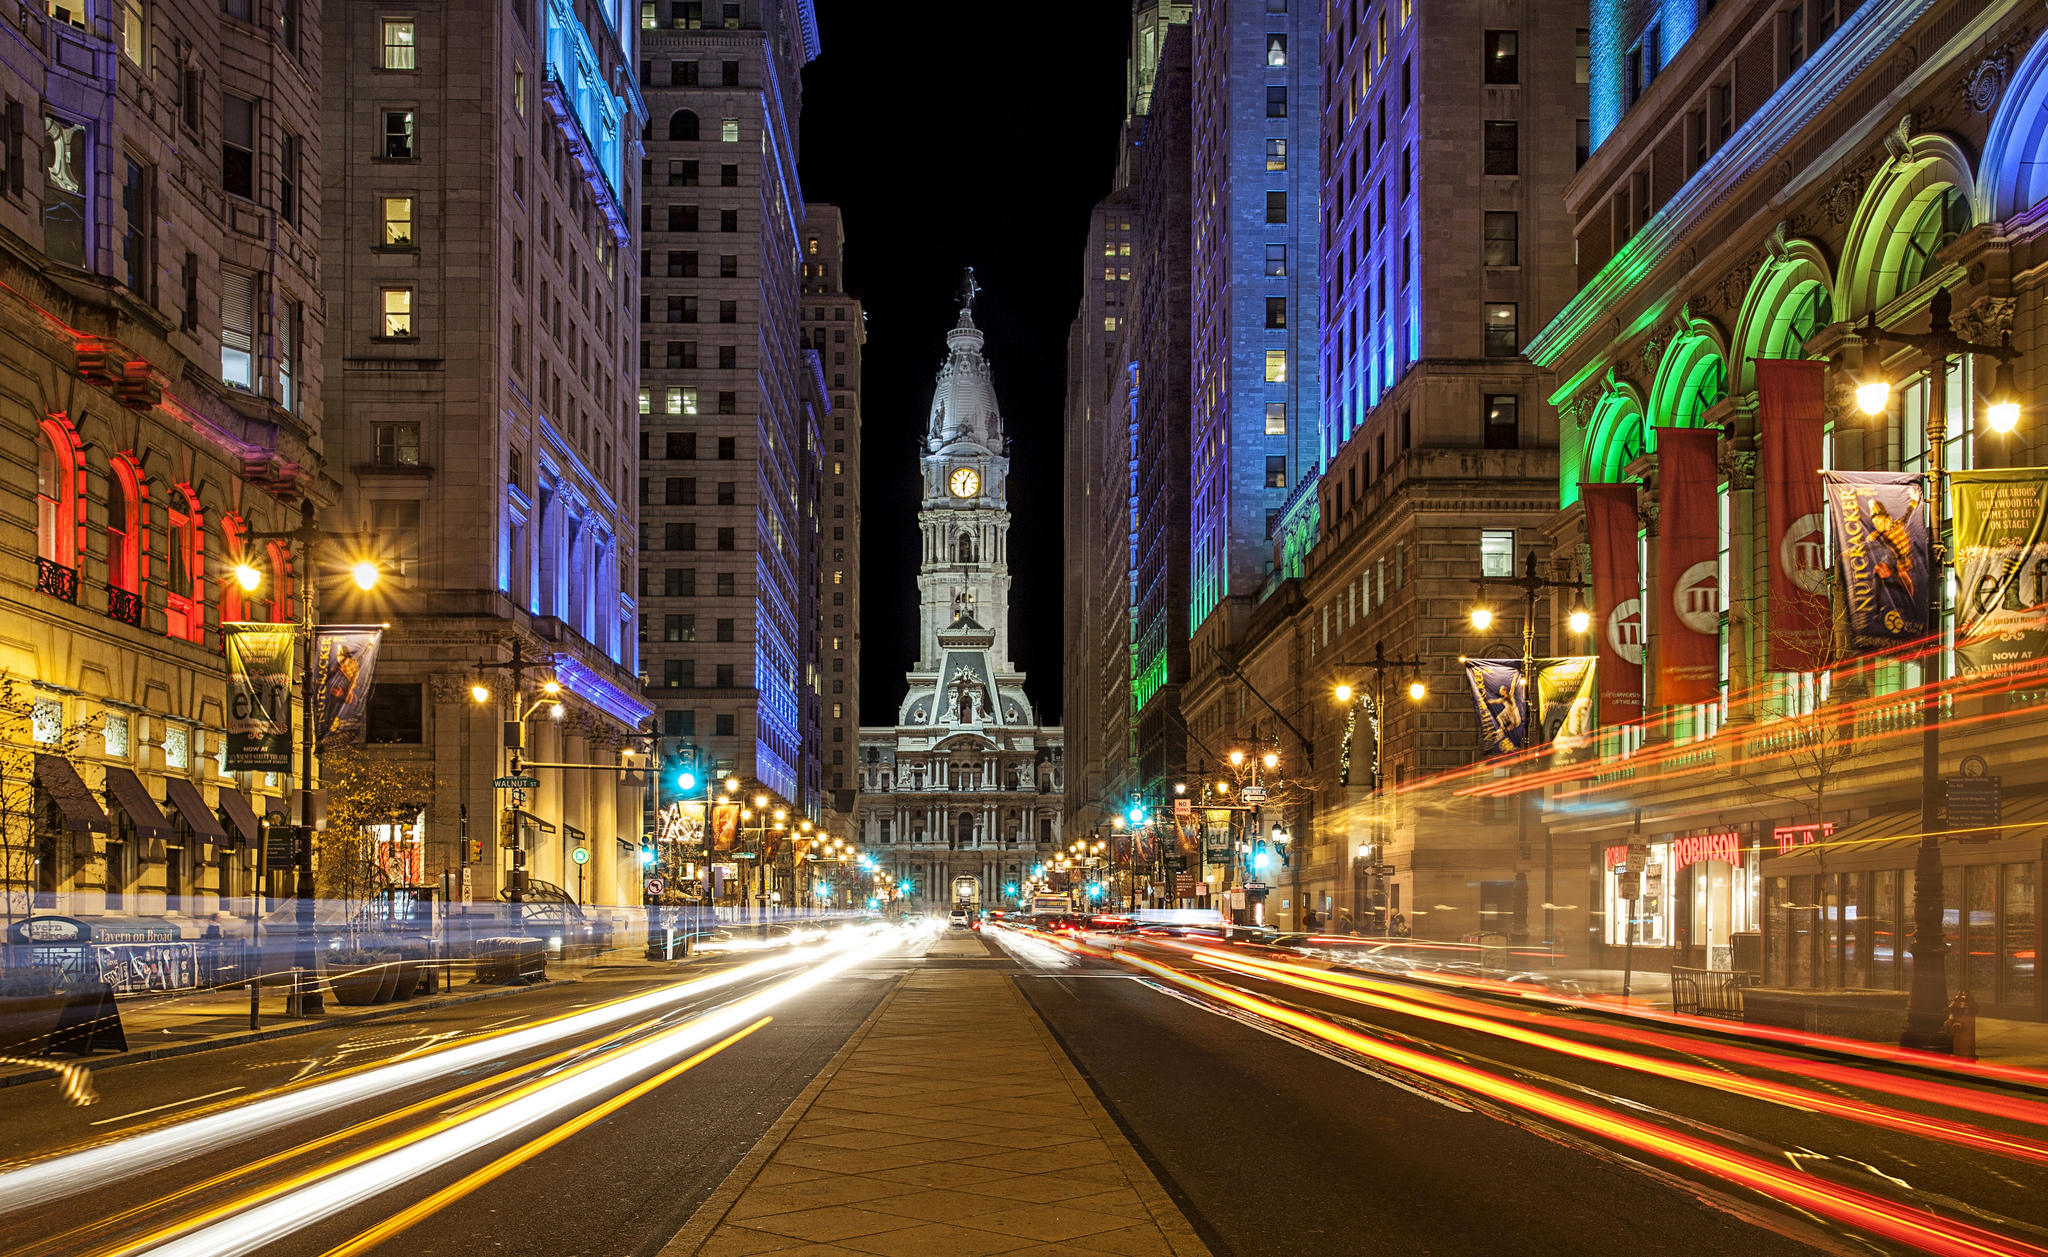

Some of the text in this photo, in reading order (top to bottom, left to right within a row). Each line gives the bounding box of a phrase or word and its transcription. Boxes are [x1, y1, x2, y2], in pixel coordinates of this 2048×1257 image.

[1981, 487, 2036, 498] THE HILARIOUS
[1976, 498, 2040, 509] HOLLYWOOD FILM
[1981, 509, 2037, 519] COMES TO LIFE
[1990, 519, 2029, 530] ON STAGE!
[1840, 488, 1874, 612] NUTCRACKER
[1992, 652, 2018, 660] NOW
[1980, 663, 2007, 672] WALNUT
[1210, 830, 1228, 845] elf
[1674, 832, 1740, 874] ROBINSON
[20, 922, 62, 932] Tavern
[40, 930, 77, 941] Broad
[99, 928, 173, 943] Tavern on Broad
